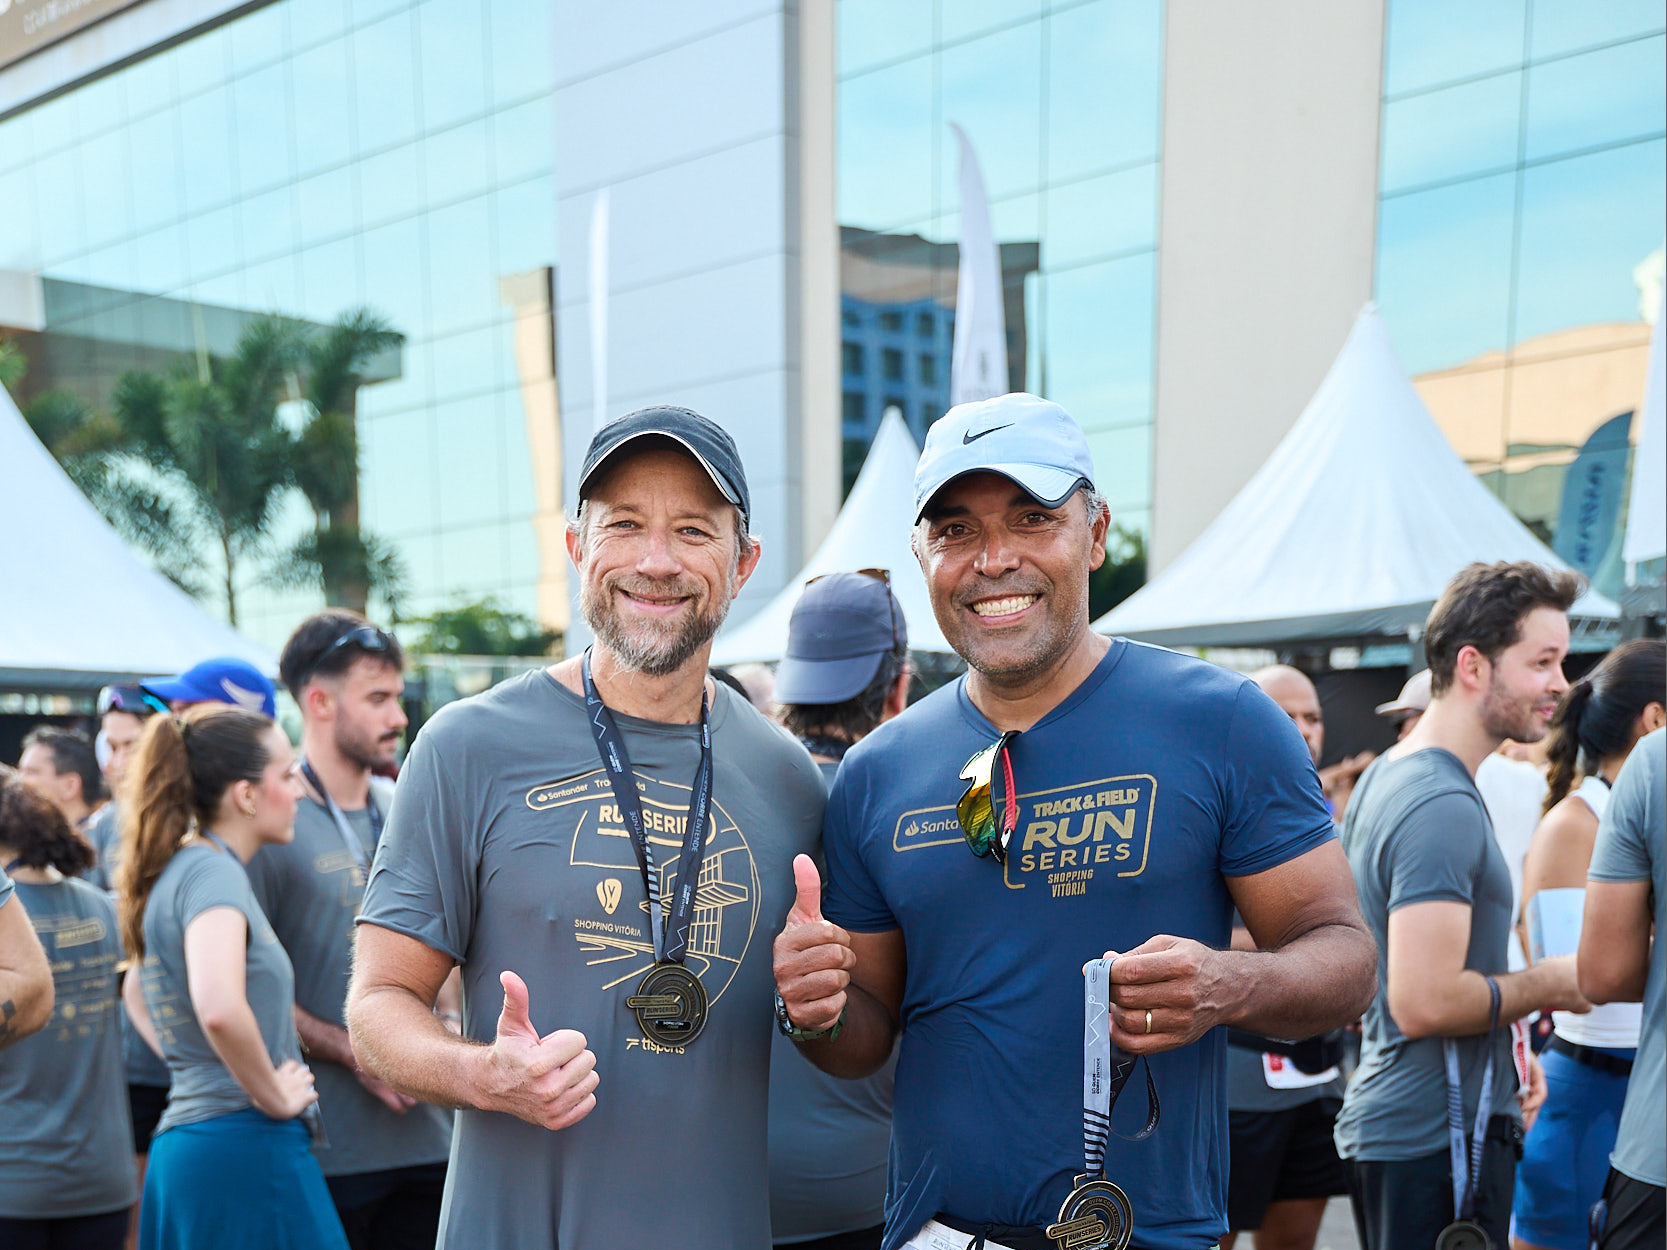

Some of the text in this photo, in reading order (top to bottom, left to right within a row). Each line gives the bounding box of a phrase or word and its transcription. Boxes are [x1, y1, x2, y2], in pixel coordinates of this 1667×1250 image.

[547, 784, 589, 800] Santander
[1033, 788, 1140, 818] TRACK&FIELD
[642, 809, 689, 835] SERI
[920, 819, 959, 834] Santa
[1022, 809, 1136, 851] RUN
[1021, 843, 1131, 872] SERIES
[1048, 869, 1094, 884] SHOPPING
[1052, 879, 1086, 898] VITÓRIA
[574, 919, 642, 937] SHOPPING VITÓRIA
